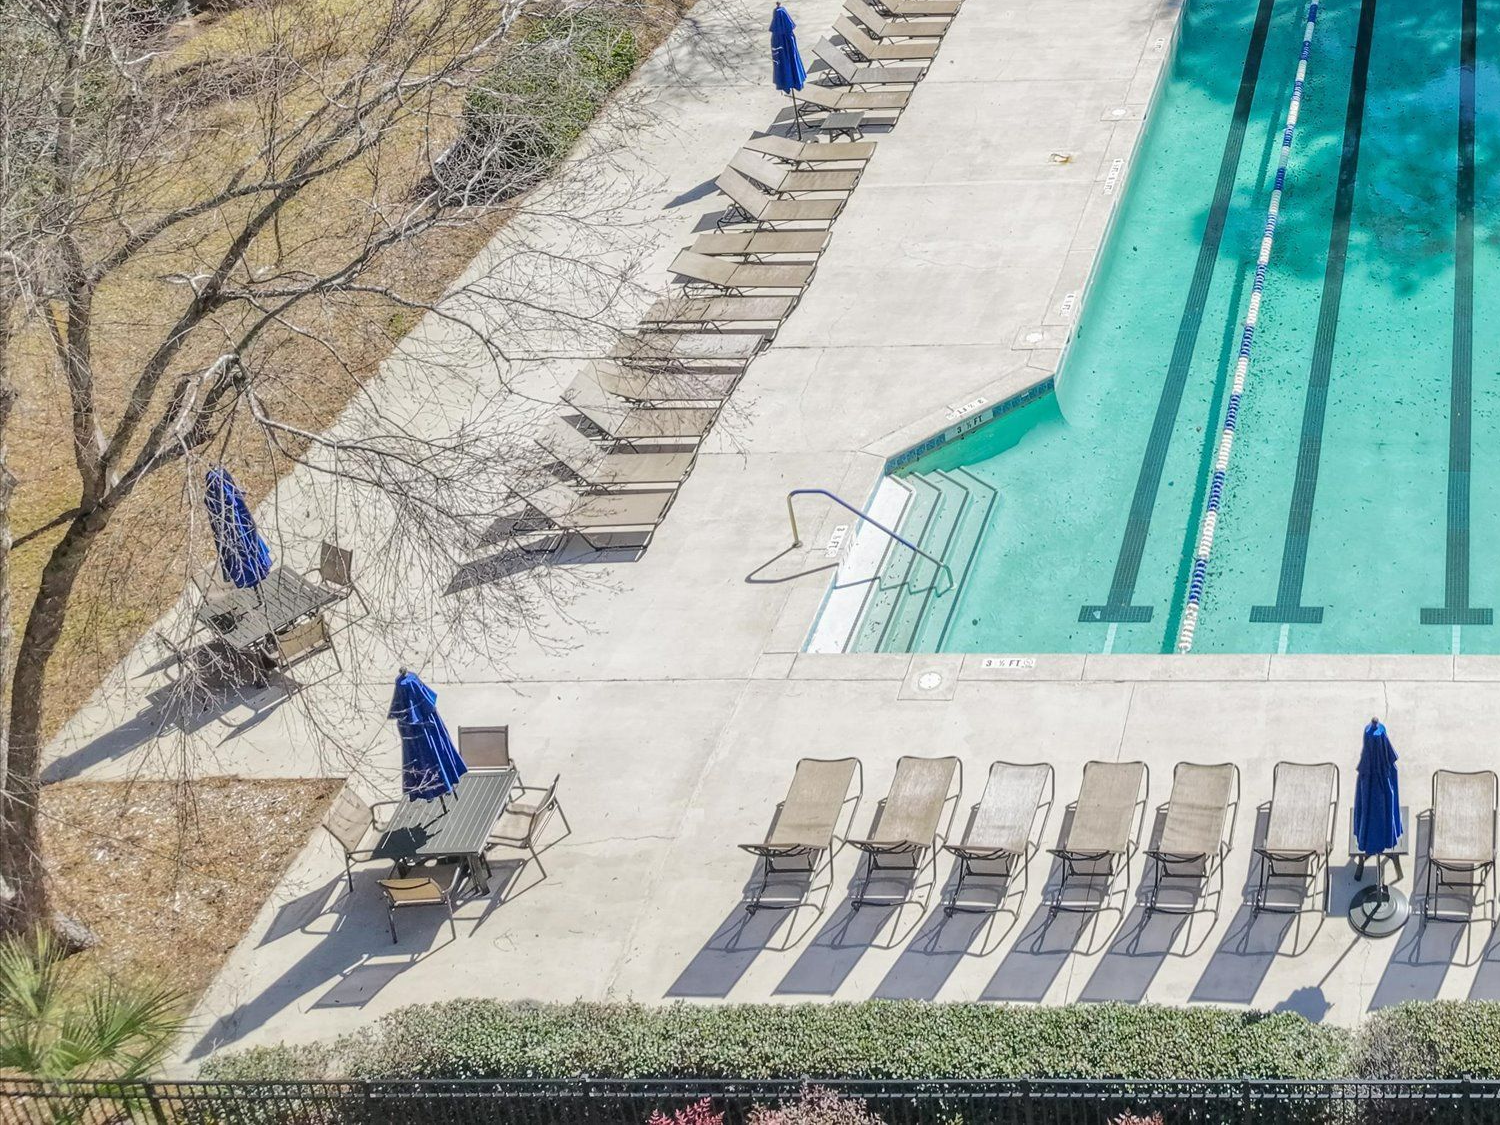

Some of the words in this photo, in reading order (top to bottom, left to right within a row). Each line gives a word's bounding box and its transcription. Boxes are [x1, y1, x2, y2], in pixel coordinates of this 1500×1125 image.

[956, 426, 962, 434] 3
[973, 414, 983, 426] FT
[985, 659, 993, 667] 3
[1009, 659, 1021, 667] FT
